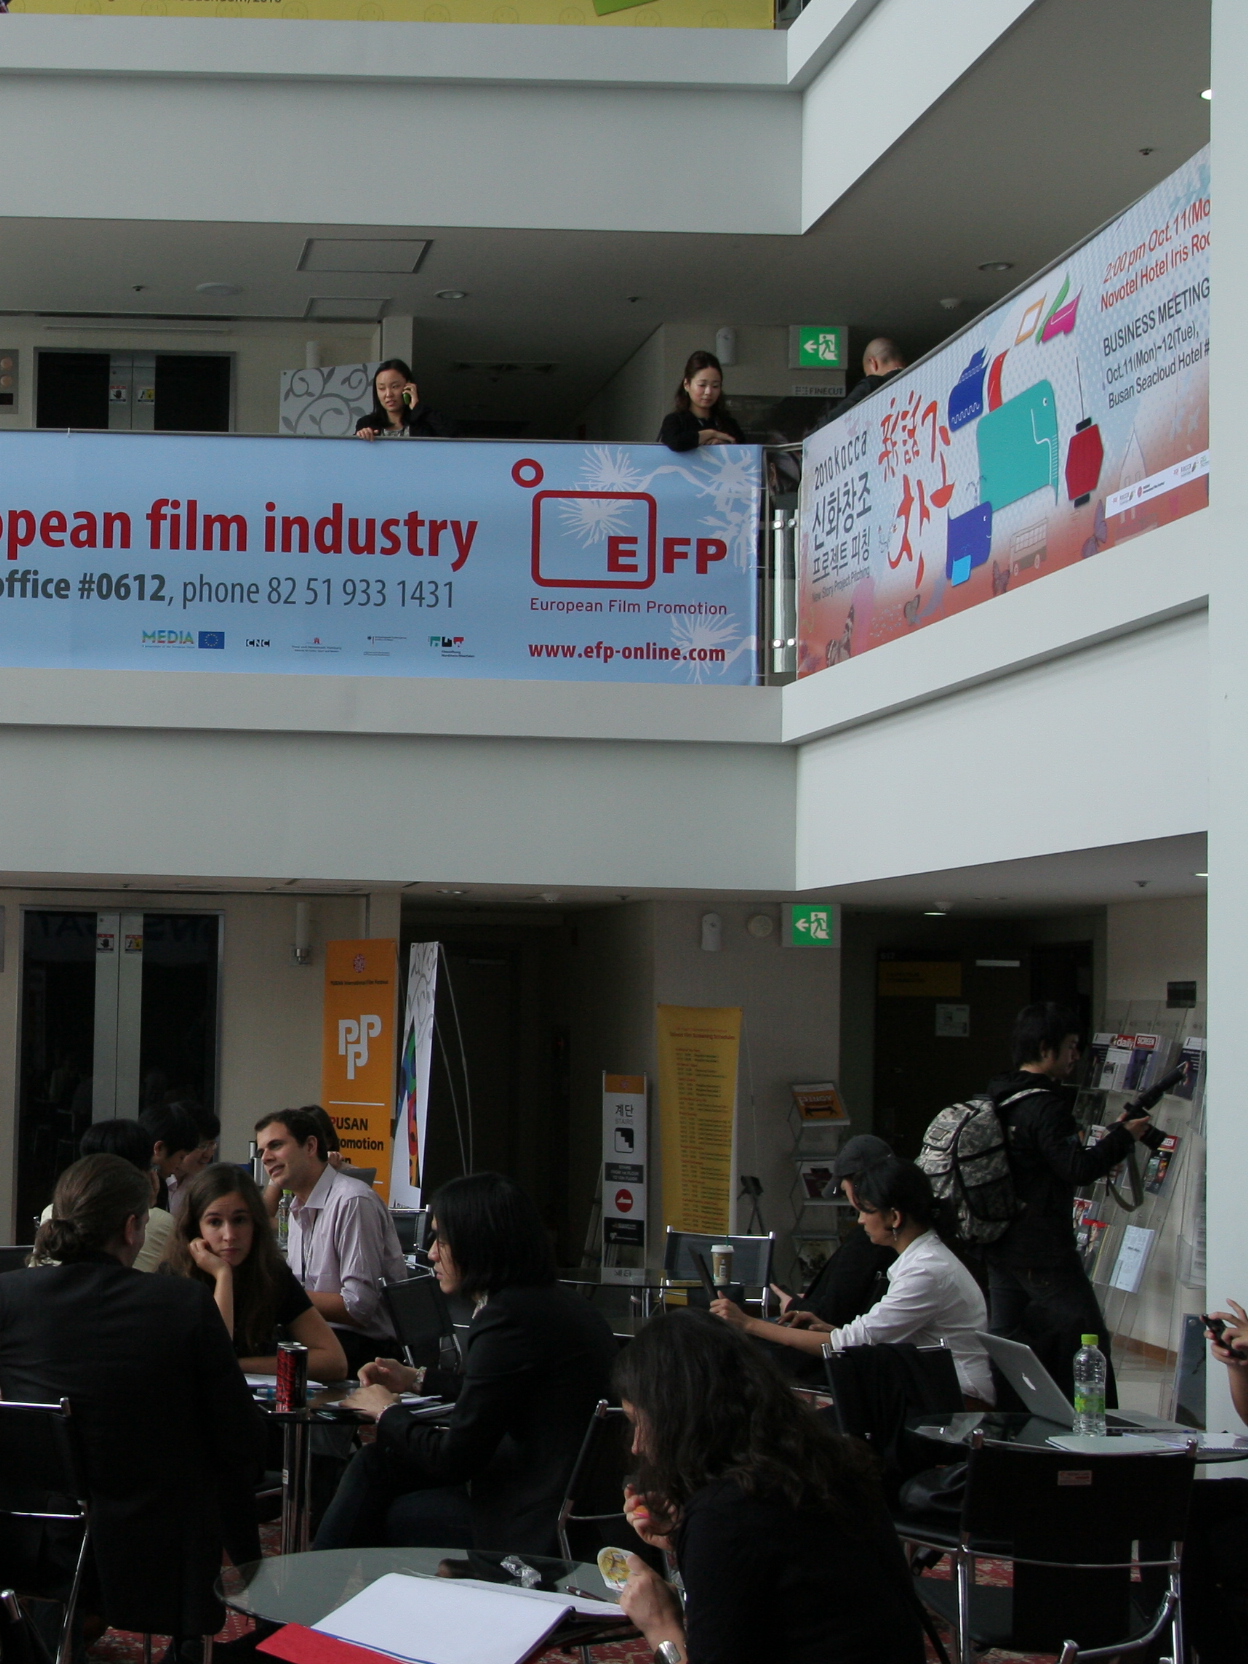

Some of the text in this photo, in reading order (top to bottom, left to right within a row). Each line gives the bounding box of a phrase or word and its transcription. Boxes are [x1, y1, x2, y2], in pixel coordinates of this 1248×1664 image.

[1128, 242, 1146, 273] pm
[1100, 278, 1139, 313] Novotel
[1140, 252, 1168, 287] Hotel
[1171, 244, 1189, 270] Iris
[1103, 277, 1210, 357] BUSINESS MEETING
[1108, 385, 1135, 409] Busan
[1136, 359, 1177, 395] Seacloud
[1178, 343, 1203, 374] Hotel
[814, 456, 834, 491] 2010
[812, 471, 872, 551] 신화창조
[146, 498, 248, 552] film
[264, 501, 479, 573] industry
[607, 535, 728, 575] EFP
[812, 525, 871, 584] 프로젝트 피칭
[78, 572, 175, 606] #0612,
[182, 574, 260, 610] phone
[268, 577, 297, 605] 82
[305, 578, 333, 606] 51
[342, 578, 387, 607] 933
[397, 580, 454, 609] 1431
[530, 597, 728, 616] European Film Promotion
[141, 629, 194, 645] MEDIA
[528, 641, 726, 663] www.efp-online.com
[615, 1104, 634, 1118] 계단
